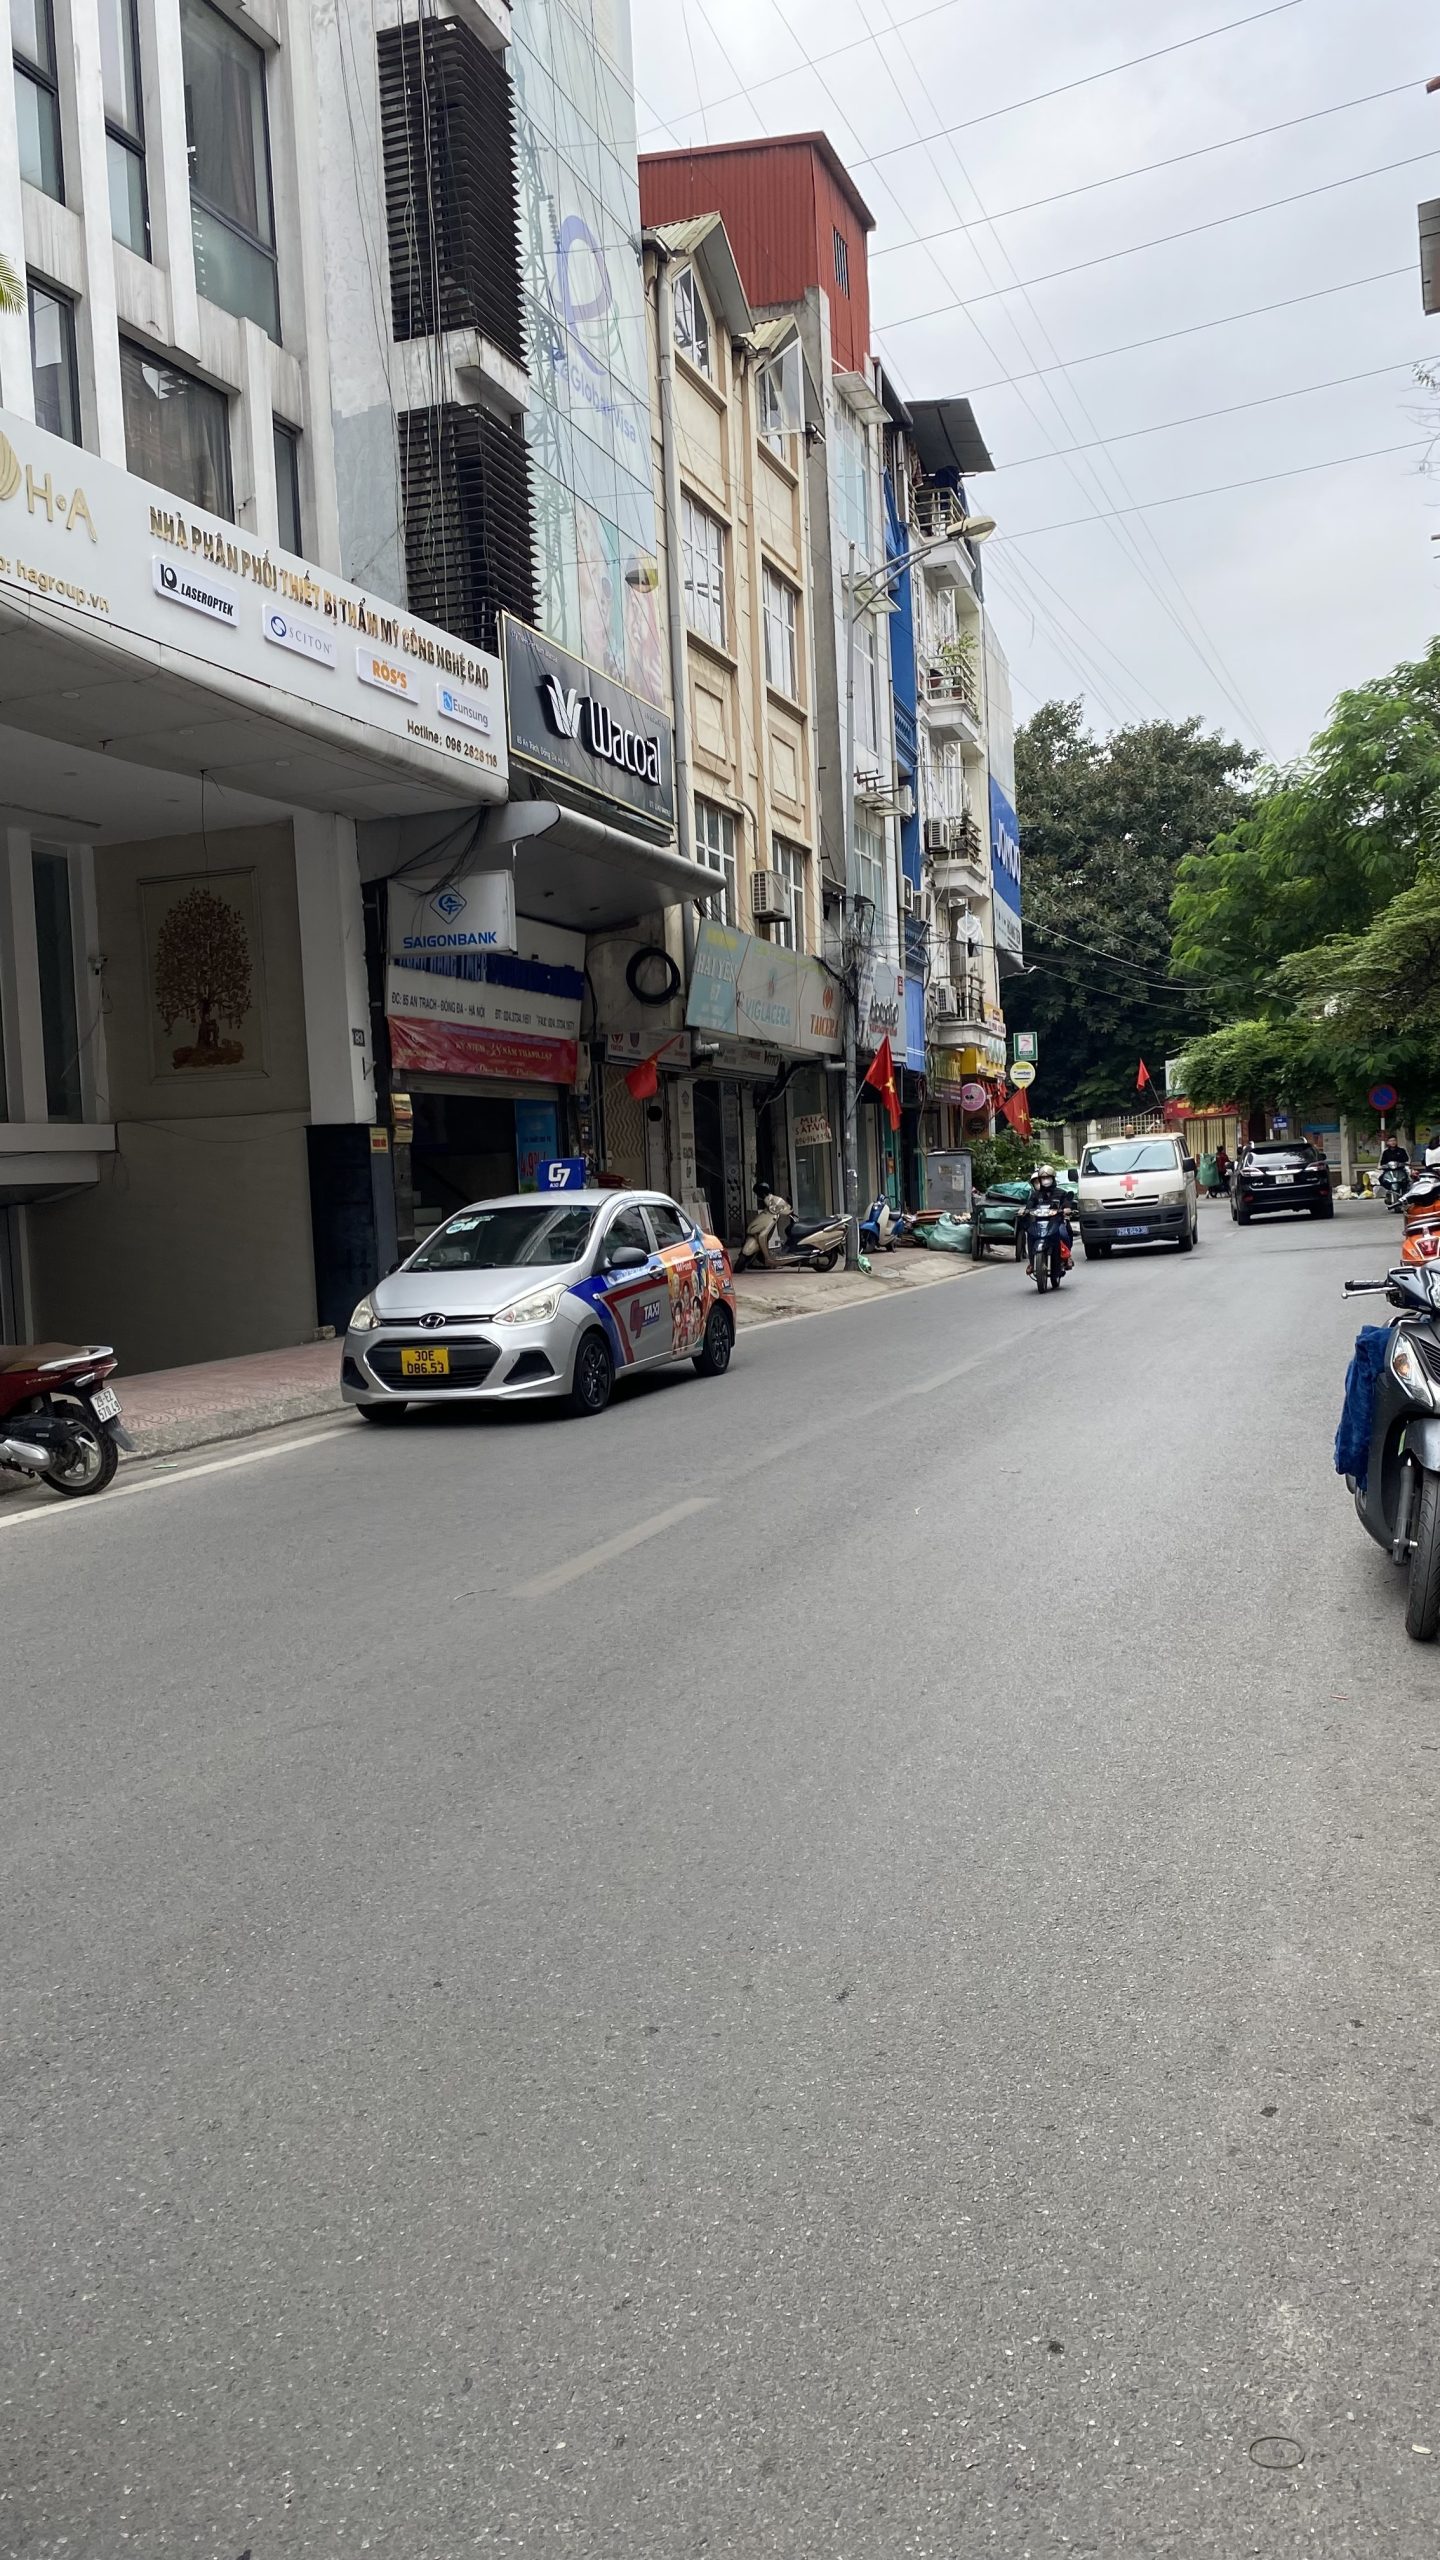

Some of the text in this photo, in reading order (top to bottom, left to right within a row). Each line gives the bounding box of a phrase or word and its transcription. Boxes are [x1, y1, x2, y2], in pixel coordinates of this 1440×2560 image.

[16, 559, 110, 613] hagroup.vn
[180, 583, 233, 617] LASEROPTEK
[191, 525, 238, 574] PHÂN
[241, 549, 278, 592] PHỐI
[279, 569, 320, 610] THIẾT
[323, 591, 338, 625] BỊ
[339, 597, 379, 637] THẨM
[381, 618, 400, 648] MỸ
[402, 626, 434, 664] CÔNG
[436, 644, 466, 685] NGHỆ
[467, 662, 490, 690] CAO
[289, 628, 331, 654] SCITON
[453, 698, 488, 728] Eunsung
[407, 719, 443, 747] Hotline:
[445, 735, 462, 753] 096
[585, 696, 662, 786] Wacoal
[403, 931, 497, 949] SAIGONBANK
[410, 995, 418, 1008] AN
[746, 997, 791, 1027] VIGLACERA
[810, 1014, 839, 1039] TAICERA
[548, 1162, 571, 1188] G7
[644, 1302, 660, 1321] TAXI
[407, 1361, 444, 1374] 086.53
[414, 1350, 435, 1362] 30E
[94, 1391, 114, 1407] 29-E2
[98, 1402, 121, 1421] 570.49
